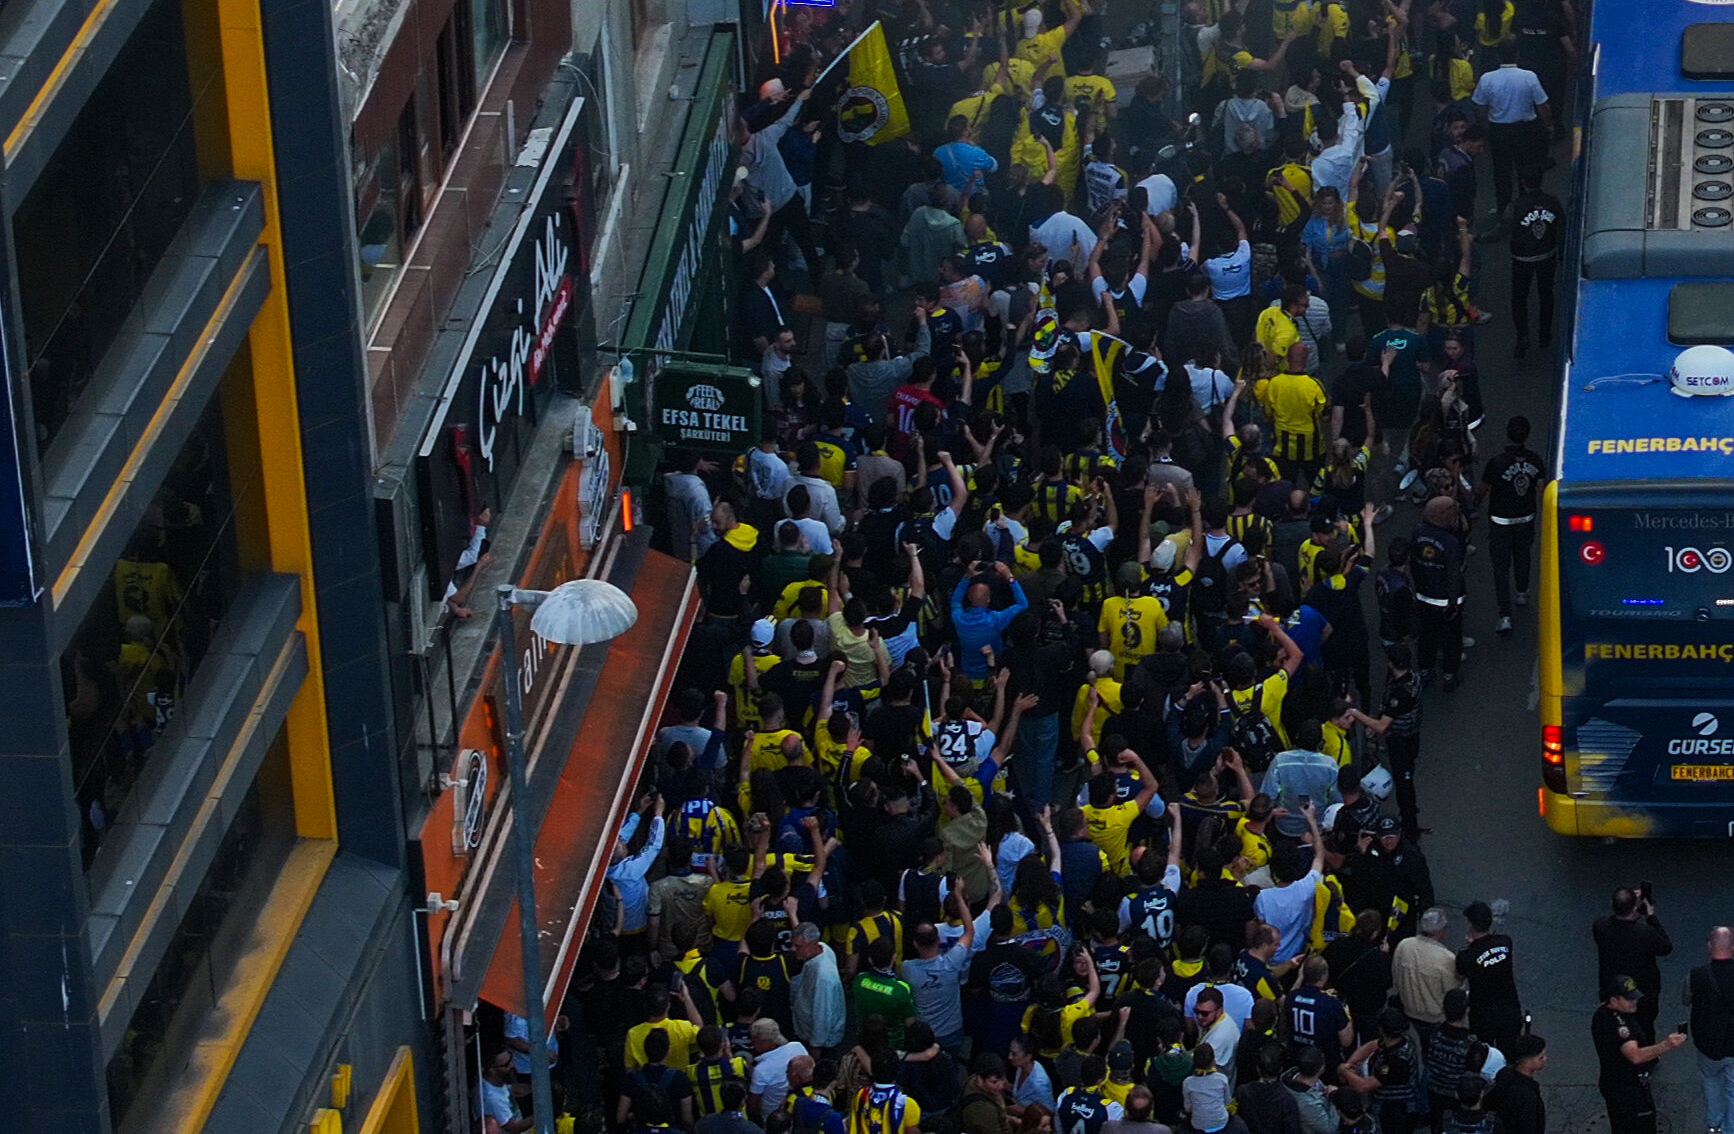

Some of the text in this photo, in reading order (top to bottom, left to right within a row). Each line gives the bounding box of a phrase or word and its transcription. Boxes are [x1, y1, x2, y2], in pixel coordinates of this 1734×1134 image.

[533, 211, 568, 336] Ali
[696, 385, 716, 397] FEEL
[1686, 376, 1729, 386] SETCOM
[663, 408, 749, 432] EFSA TEKEL
[1589, 609, 1681, 618] TOURISMO
[939, 734, 968, 757] 24
[1140, 909, 1174, 941] 10
[1099, 973, 1120, 996] 7
[1292, 1007, 1315, 1034] 10
